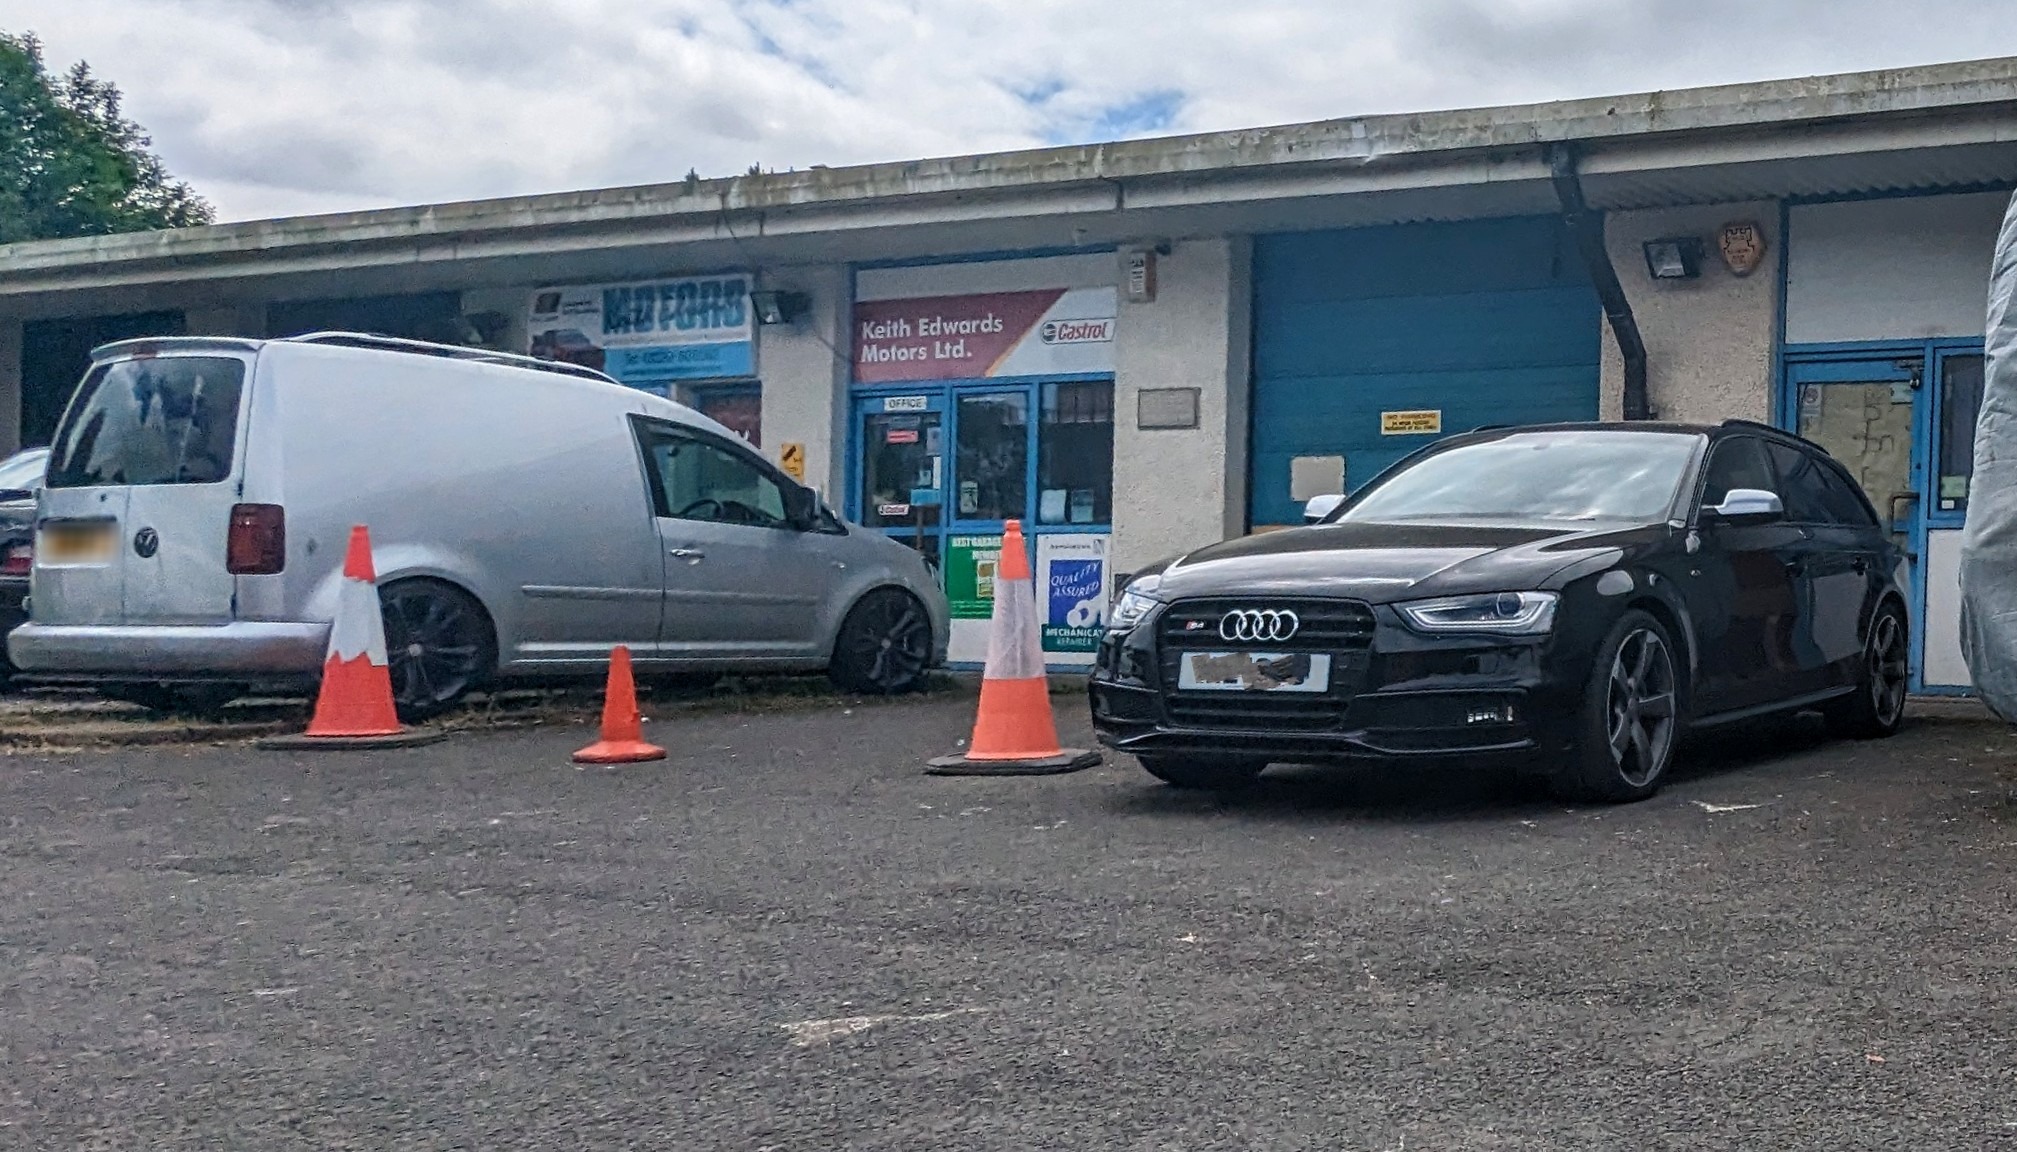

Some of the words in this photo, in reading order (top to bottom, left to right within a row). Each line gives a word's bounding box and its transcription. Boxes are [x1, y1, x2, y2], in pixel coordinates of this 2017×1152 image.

[862, 318, 911, 339] Keith
[919, 313, 1003, 336] Edwards
[1058, 322, 1108, 340] Castrol
[861, 344, 927, 362] Motors
[935, 339, 972, 359] Ltd.
[889, 398, 922, 408] OFFICE
[1051, 561, 1100, 586] QUALITY
[1053, 581, 1099, 597] ASSURED
